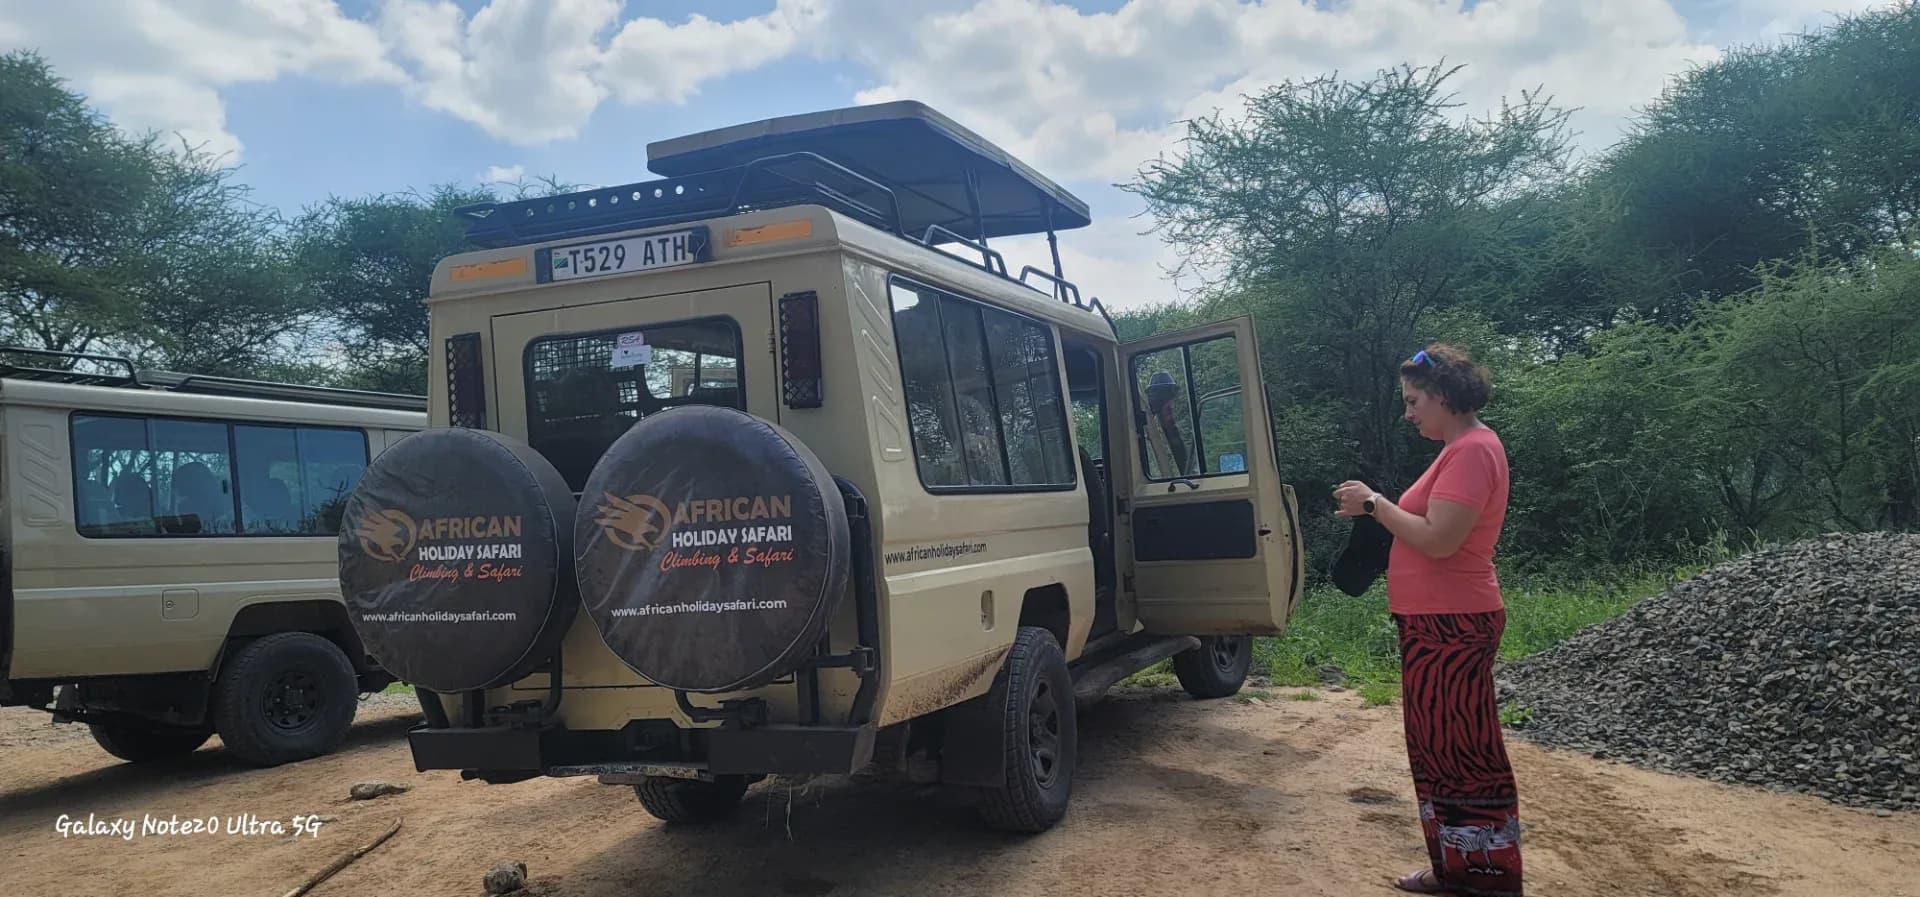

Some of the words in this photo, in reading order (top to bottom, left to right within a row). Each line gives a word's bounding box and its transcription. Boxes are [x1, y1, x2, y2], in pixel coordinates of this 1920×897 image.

[643, 234, 687, 266] ATH
[671, 495, 791, 525] AFRICAN
[418, 515, 522, 541] AFRICAN
[672, 528, 738, 548] HOLIDAY
[741, 526, 793, 544] SAFARI
[418, 545, 474, 561] HOLIDAY
[476, 544, 522, 559] SAFARI
[660, 551, 721, 572] Climbing
[727, 547, 738, 564] &
[743, 548, 794, 568] Safari
[884, 541, 988, 565] www.africanholidaysafari.com
[409, 563, 459, 583] Climbing
[464, 562, 474, 578] &
[477, 563, 523, 583] Safari
[362, 611, 516, 625] www.africanholidaysafari.com
[611, 598, 787, 618] www.africanholidaysafari.com
